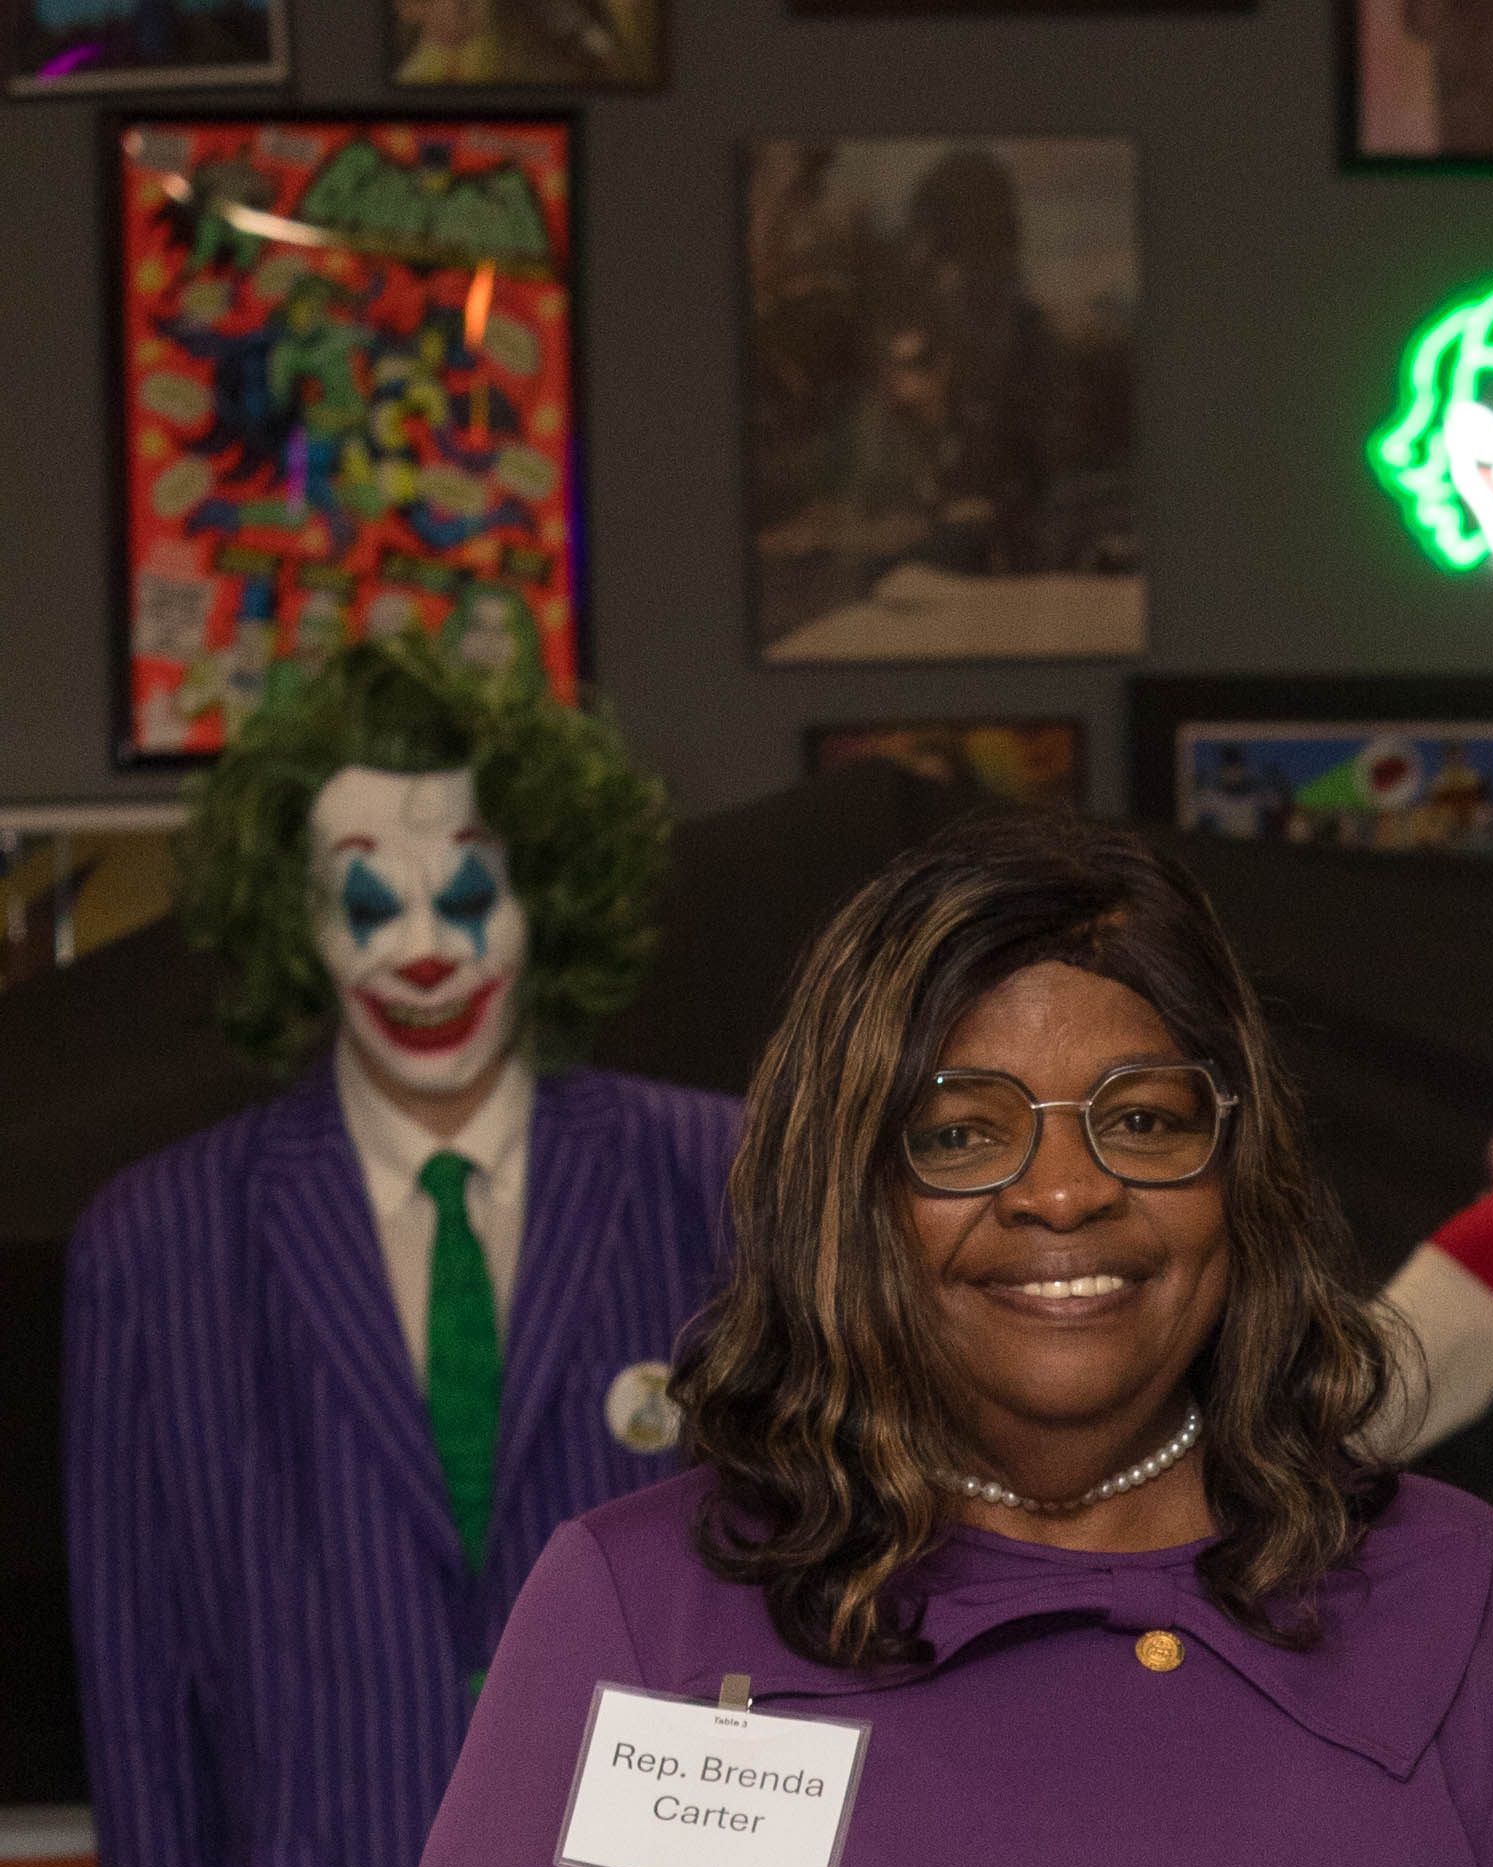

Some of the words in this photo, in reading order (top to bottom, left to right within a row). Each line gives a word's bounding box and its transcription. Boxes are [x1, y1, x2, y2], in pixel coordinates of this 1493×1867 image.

[713, 1715, 740, 1728] Table
[741, 1719, 749, 1728] 3
[611, 1741, 687, 1782] Rep.
[700, 1755, 825, 1798] Brenda
[652, 1794, 766, 1834] Carter
